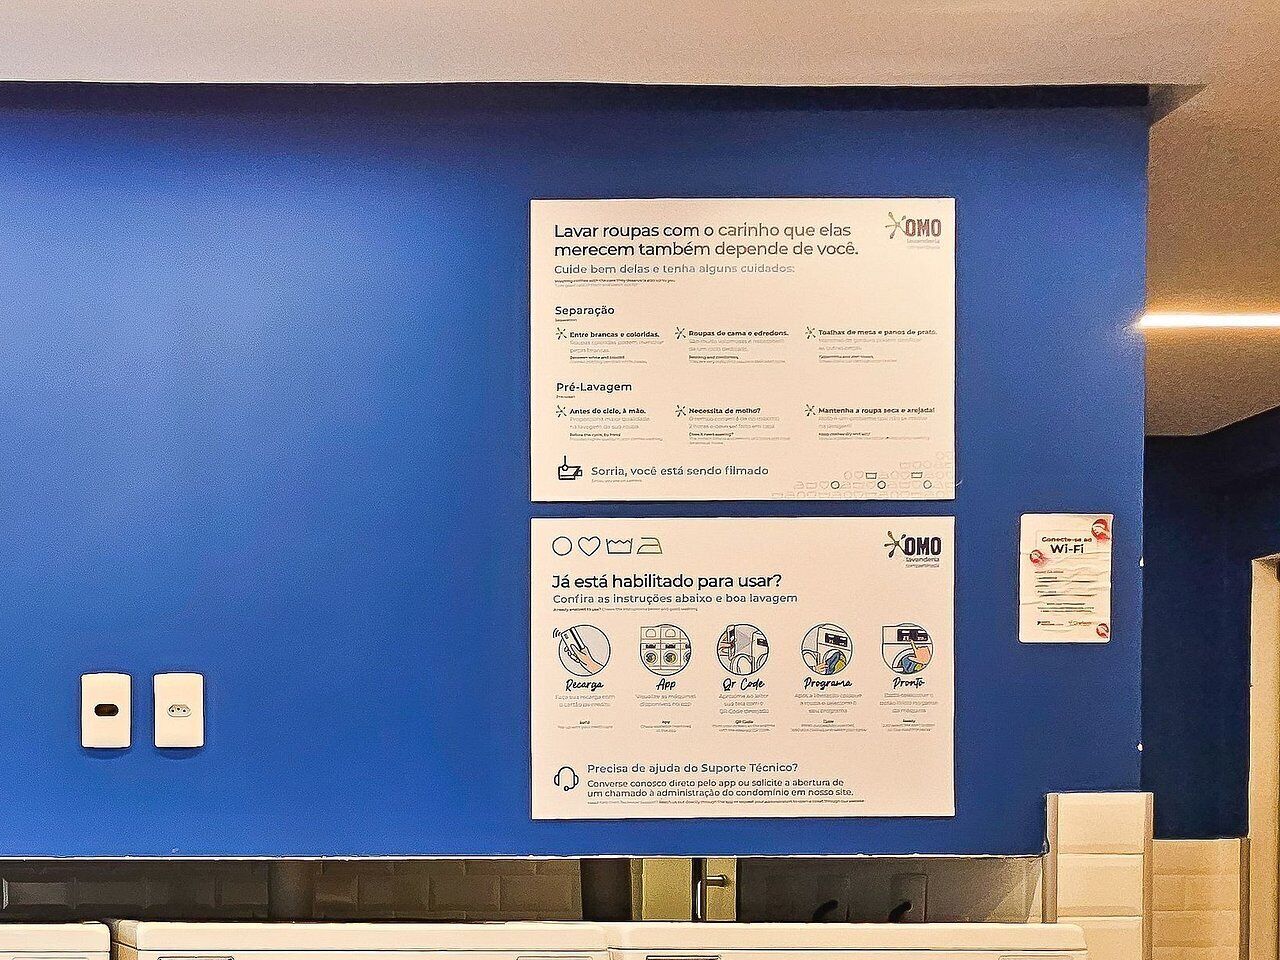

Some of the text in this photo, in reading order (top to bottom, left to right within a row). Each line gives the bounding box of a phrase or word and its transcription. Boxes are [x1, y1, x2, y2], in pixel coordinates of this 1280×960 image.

[555, 222, 851, 240] Lavar roupas com o carinho que elas
[905, 218, 942, 238] OMO
[555, 241, 858, 258] merecem também depende de você.
[554, 264, 587, 274] Cuide
[591, 264, 616, 274] bem
[620, 264, 650, 273] delas
[663, 264, 695, 273] tenha
[699, 264, 737, 275] alguns
[740, 263, 795, 273] cuidados:
[555, 305, 615, 317] Separação
[556, 382, 632, 393] Pré-Lavagem
[591, 465, 769, 477] Sorria, você está sendo filmado
[905, 536, 942, 556] OMO
[1050, 543, 1084, 554] Wi-Fi
[552, 573, 782, 590] Já está habilitado para usar?
[553, 594, 594, 604] Confira
[613, 594, 672, 605] instruções
[675, 593, 712, 603] abaixo
[726, 594, 746, 603] boa
[750, 593, 797, 605] lavagem
[565, 679, 604, 692] Recarga
[656, 678, 676, 690] App
[740, 678, 765, 691] Code
[804, 678, 853, 690] Programa
[892, 678, 925, 689] Pronto
[587, 762, 798, 775] Precisa de ajuda do Suporte Técnico?
